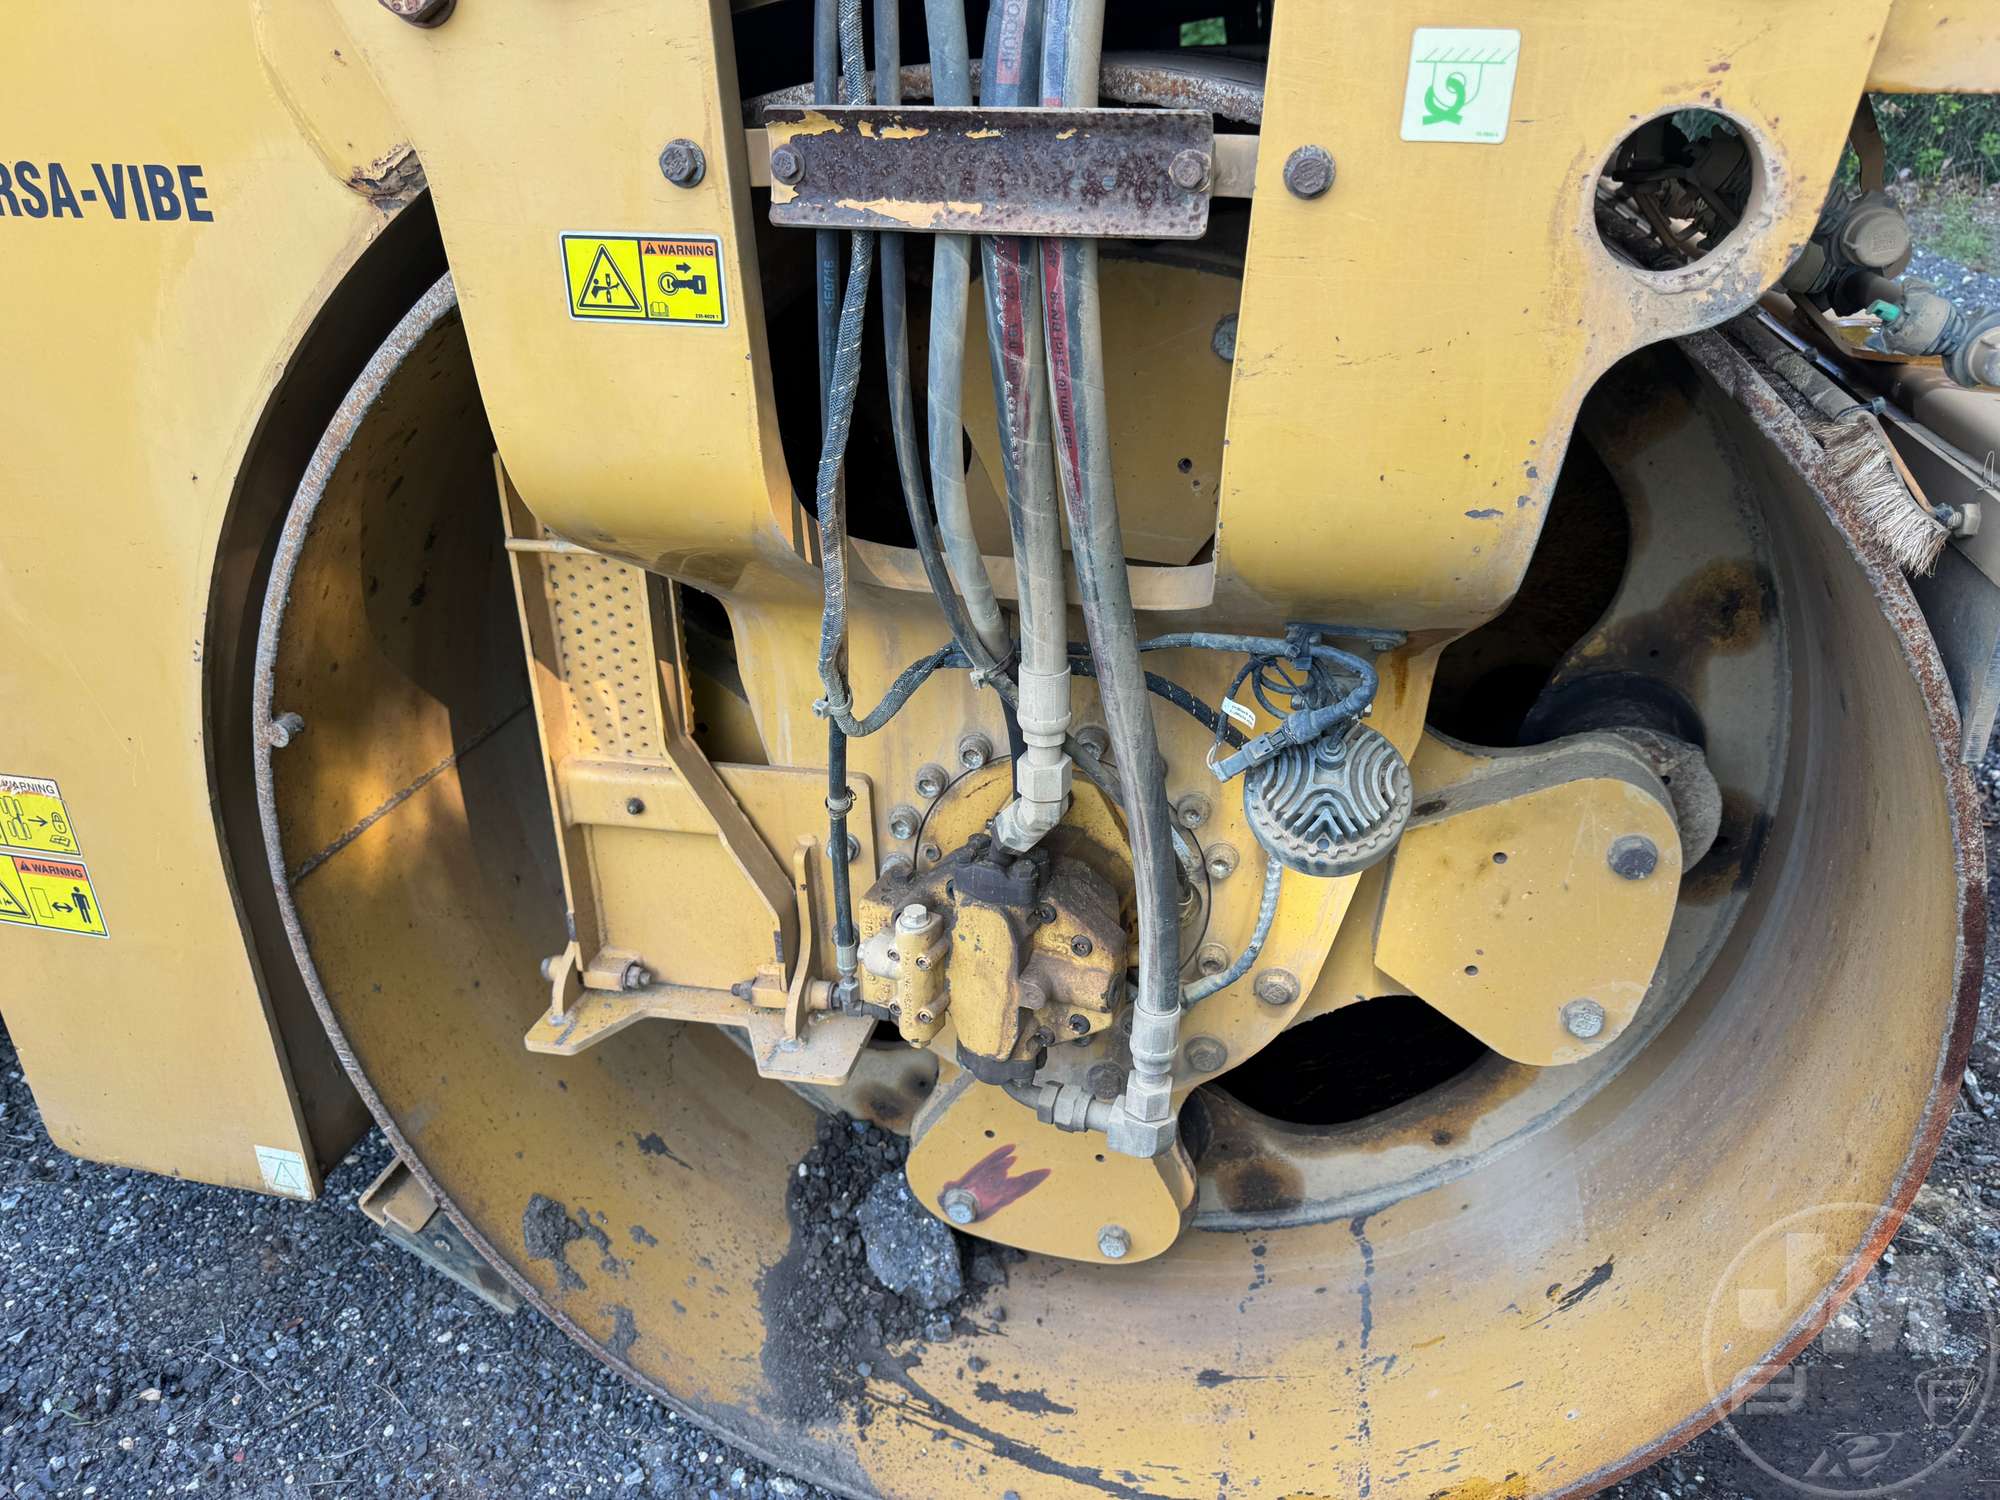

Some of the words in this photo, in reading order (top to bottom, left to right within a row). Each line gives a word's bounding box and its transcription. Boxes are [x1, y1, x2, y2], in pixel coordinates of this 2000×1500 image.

[0, 160, 214, 222] RSA-VIBE
[658, 244, 713, 256] WARNING
[32, 863, 83, 878] WARNING
